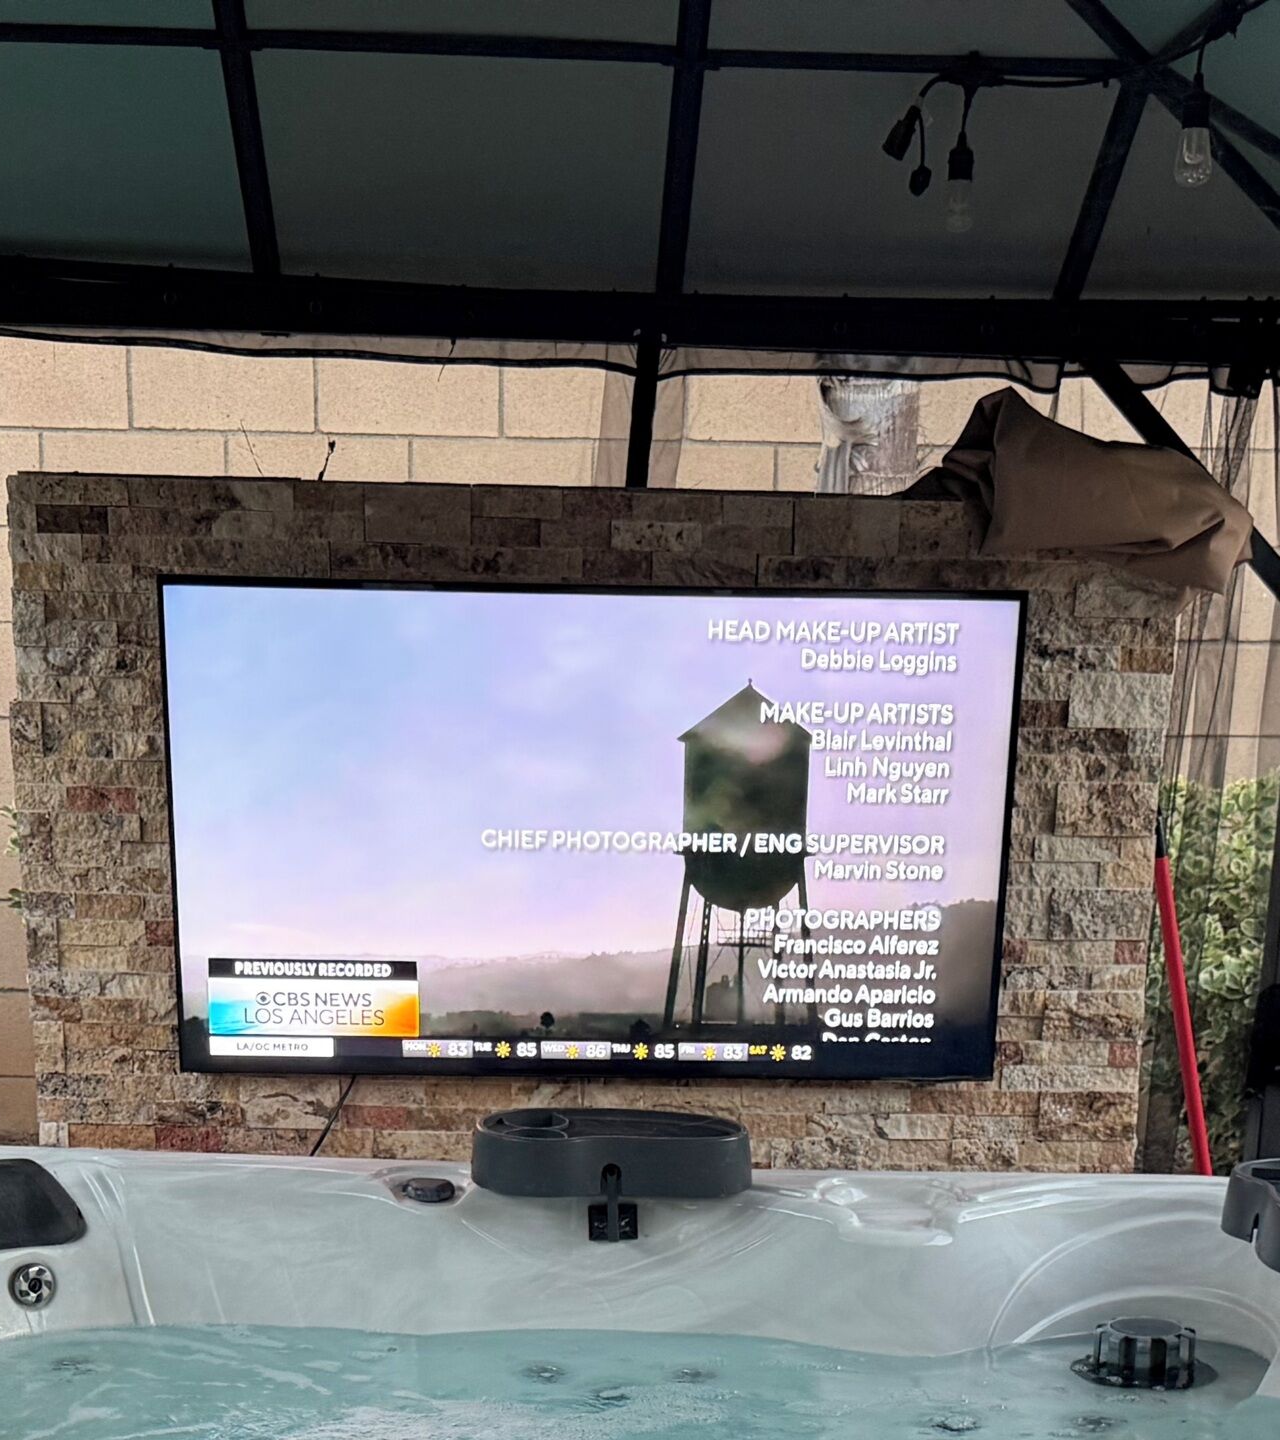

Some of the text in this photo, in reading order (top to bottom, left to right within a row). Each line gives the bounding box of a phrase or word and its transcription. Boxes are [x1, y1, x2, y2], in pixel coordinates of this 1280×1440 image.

[707, 619, 959, 645] HEAD MAKE-UP ARTIST
[801, 648, 957, 676] Debbie Loggins
[760, 702, 954, 725] MAKE-UP ARTISTS
[811, 729, 952, 752] Blair Levinthal
[824, 756, 950, 782] Linh Nguyen
[846, 782, 949, 805] Mark Starr
[481, 829, 945, 858] CHIEF PHOTOGRAPHER / ENG SUPERVISOR
[814, 859, 943, 881] Marvin Stone
[744, 907, 942, 931] PHOTOGRAPHERS
[774, 934, 940, 956] Francisco Alferez
[234, 961, 392, 978] PREVIOUSLY RECORDED
[757, 958, 937, 980] Victor Anastasia Jr.
[272, 992, 372, 1007] CBS NEWS
[762, 983, 936, 1007] Armando Aparicio
[244, 1008, 385, 1026] LOS ANGELES
[823, 1007, 934, 1029] Gus Barrios
[236, 1042, 309, 1052] LA/OC METRO
[447, 1042, 468, 1057] 83
[612, 1043, 631, 1053] THU
[749, 1045, 768, 1055] SAT
[791, 1045, 812, 1060] 82
